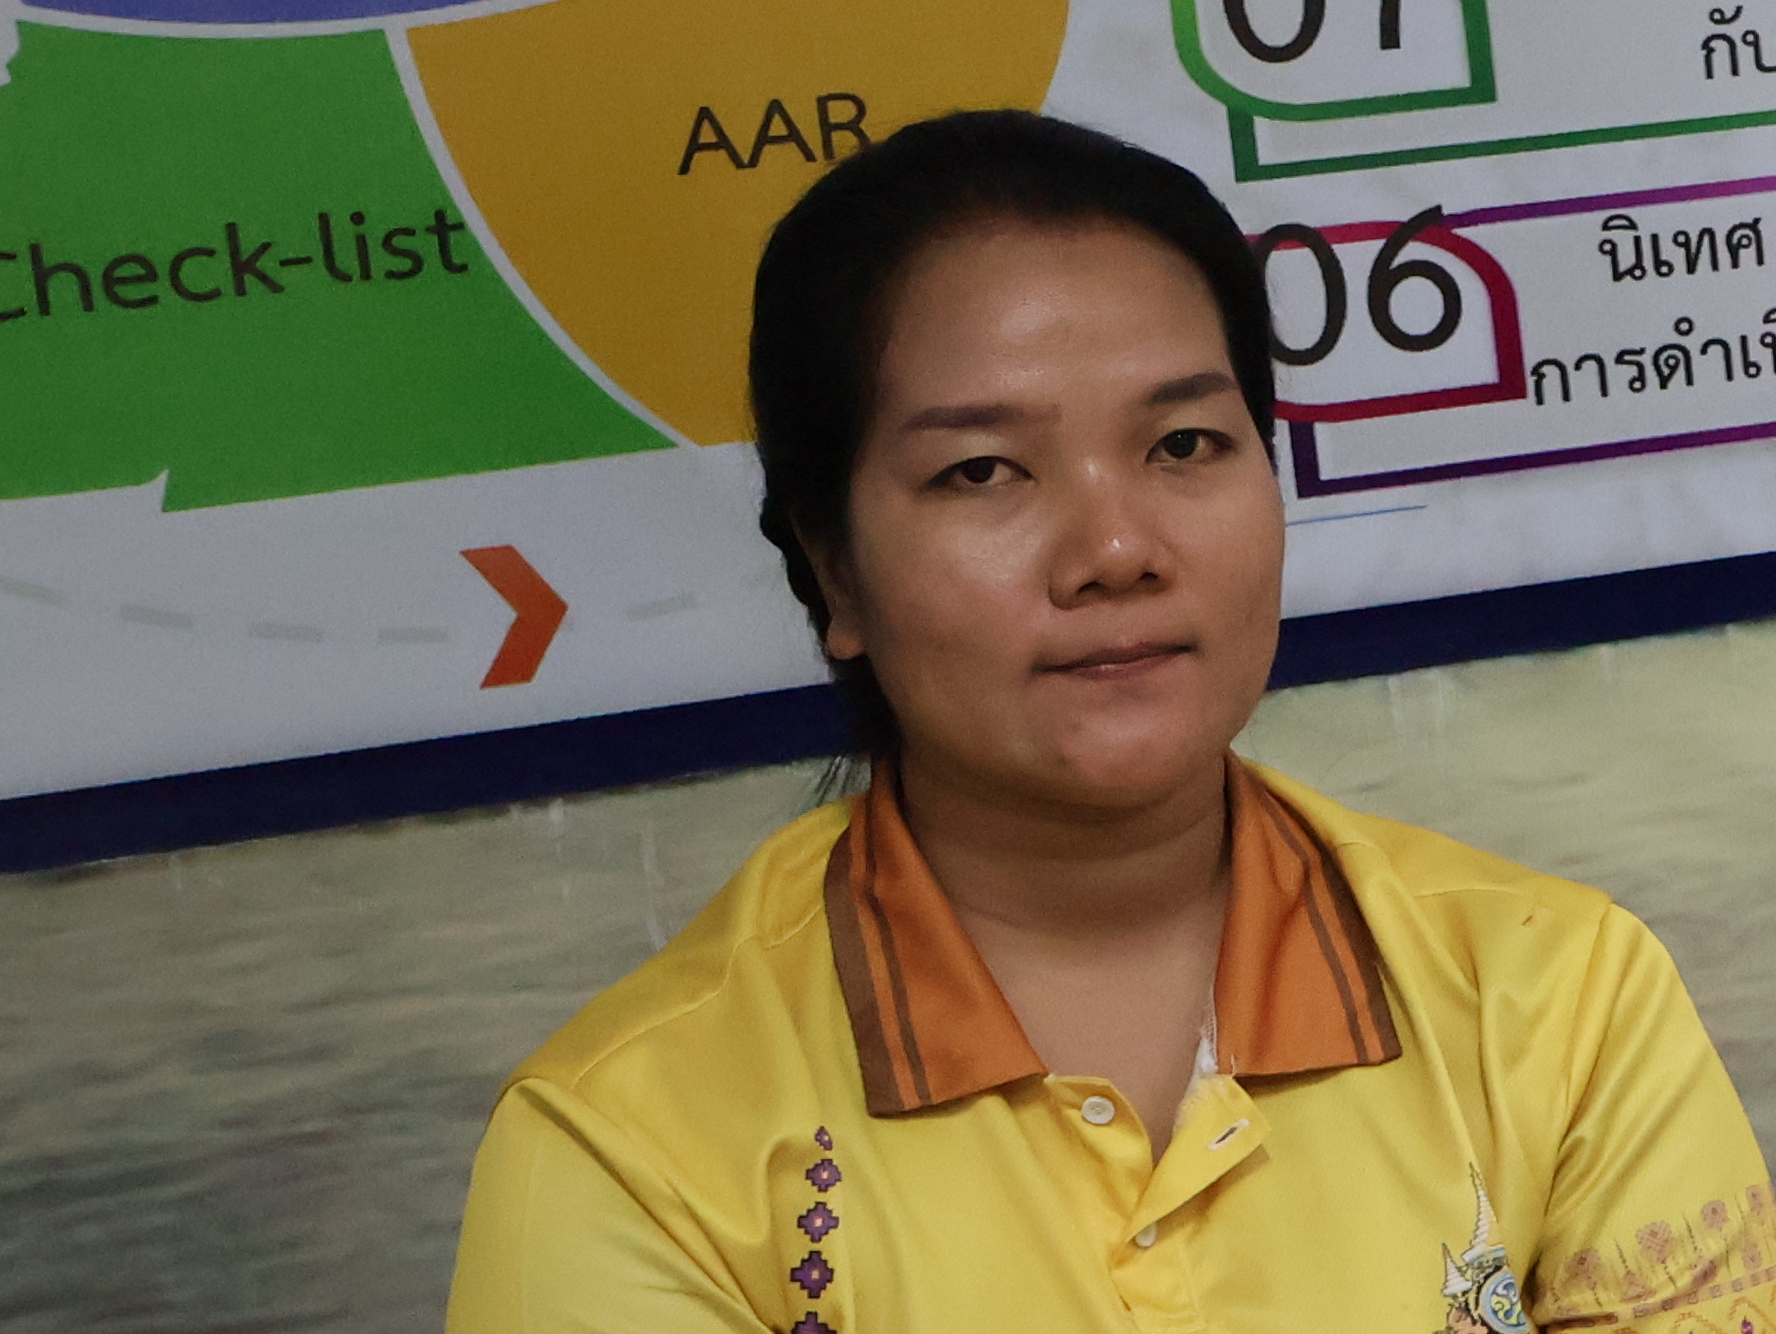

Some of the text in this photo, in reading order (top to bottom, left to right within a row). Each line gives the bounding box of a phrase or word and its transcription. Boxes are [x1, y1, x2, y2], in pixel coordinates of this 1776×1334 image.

[678, 93, 871, 175] AAR
[1250, 204, 1462, 366] 06
[1599, 214, 1765, 283] นิเทศ
